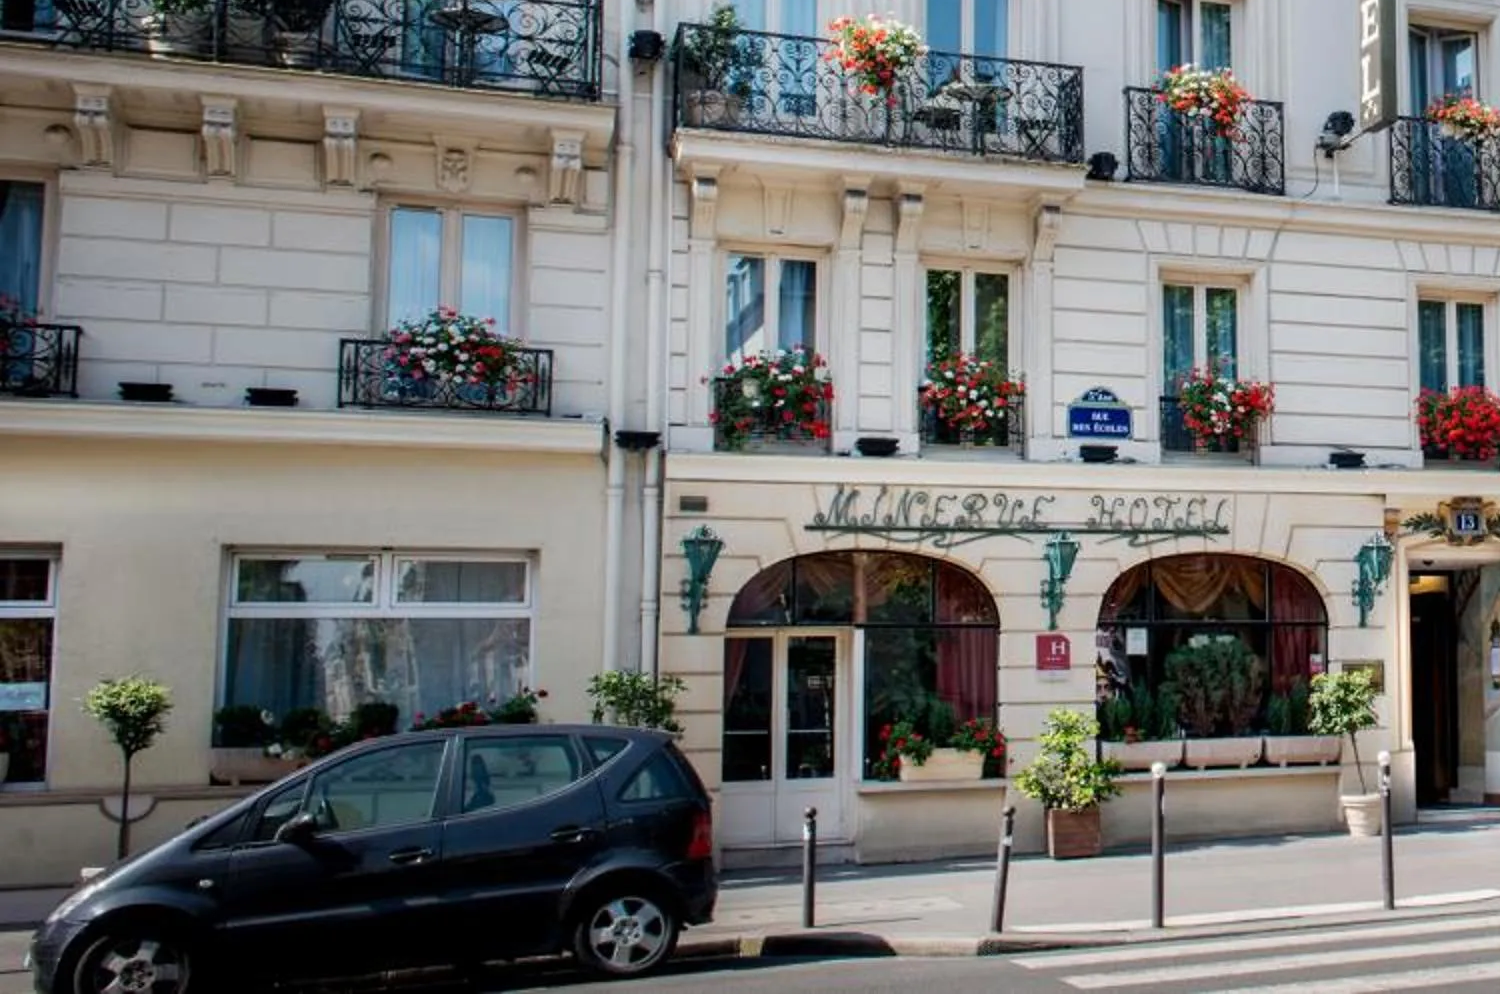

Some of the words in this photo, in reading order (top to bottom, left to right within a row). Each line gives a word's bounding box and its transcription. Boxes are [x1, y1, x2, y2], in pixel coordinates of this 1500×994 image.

[1091, 412, 1110, 421] RUE
[1072, 423, 1091, 431] DES
[813, 484, 1055, 529] MINERVE
[1088, 495, 1229, 530] HOTEL
[1461, 514, 1475, 529] 13
[1051, 641, 1065, 655] H
